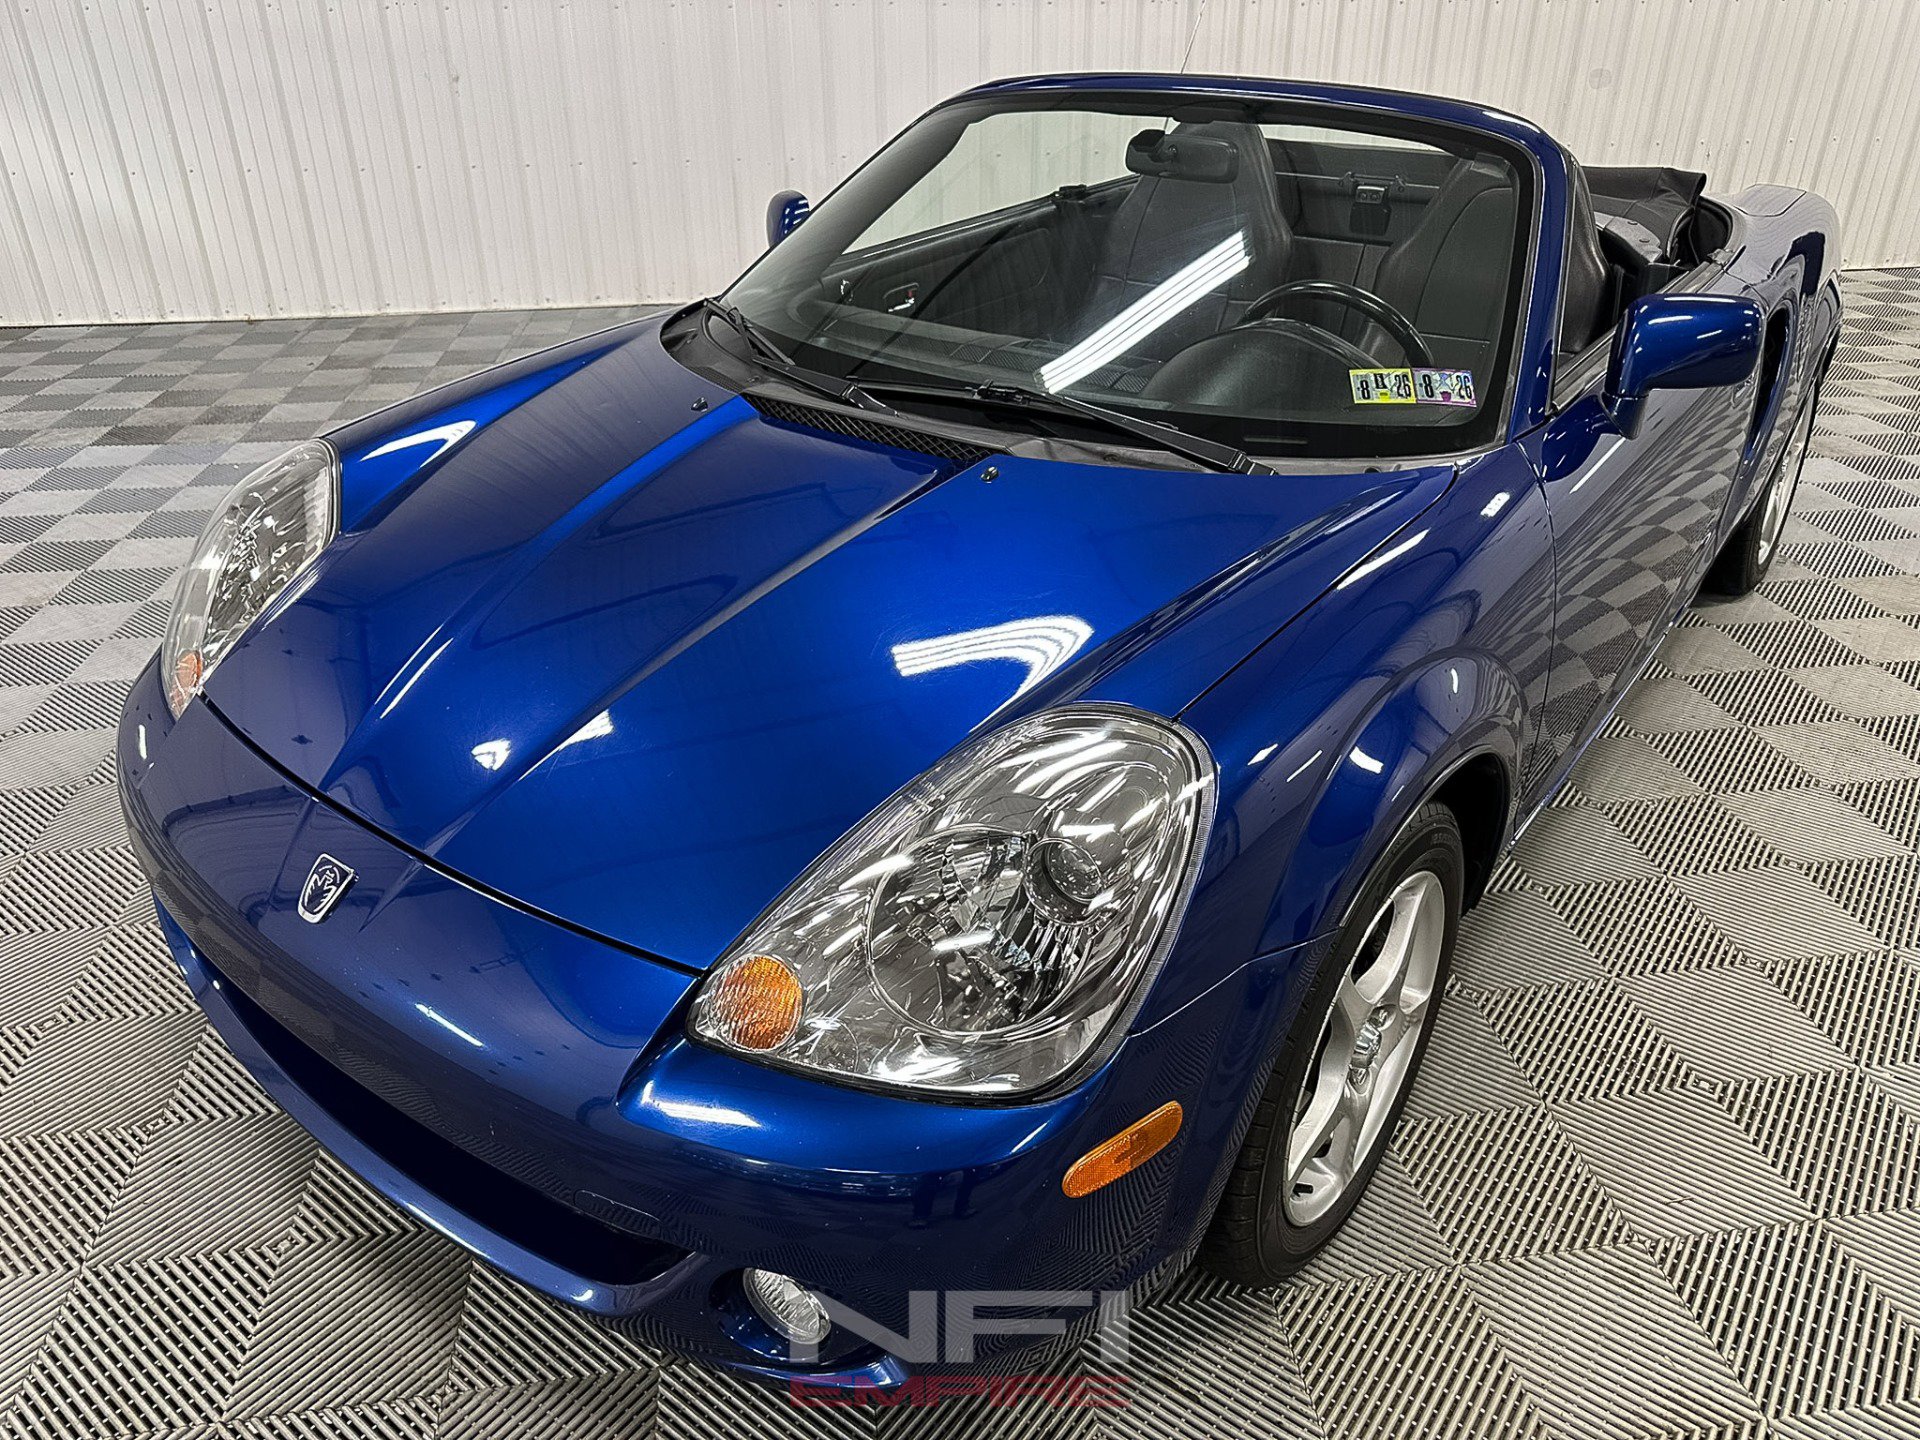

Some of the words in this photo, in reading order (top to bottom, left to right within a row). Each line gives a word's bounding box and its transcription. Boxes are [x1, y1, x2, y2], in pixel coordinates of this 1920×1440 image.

[1360, 379, 1371, 400] 8
[1394, 374, 1412, 399] 26
[1422, 374, 1434, 398] 8
[1456, 375, 1472, 400] 26
